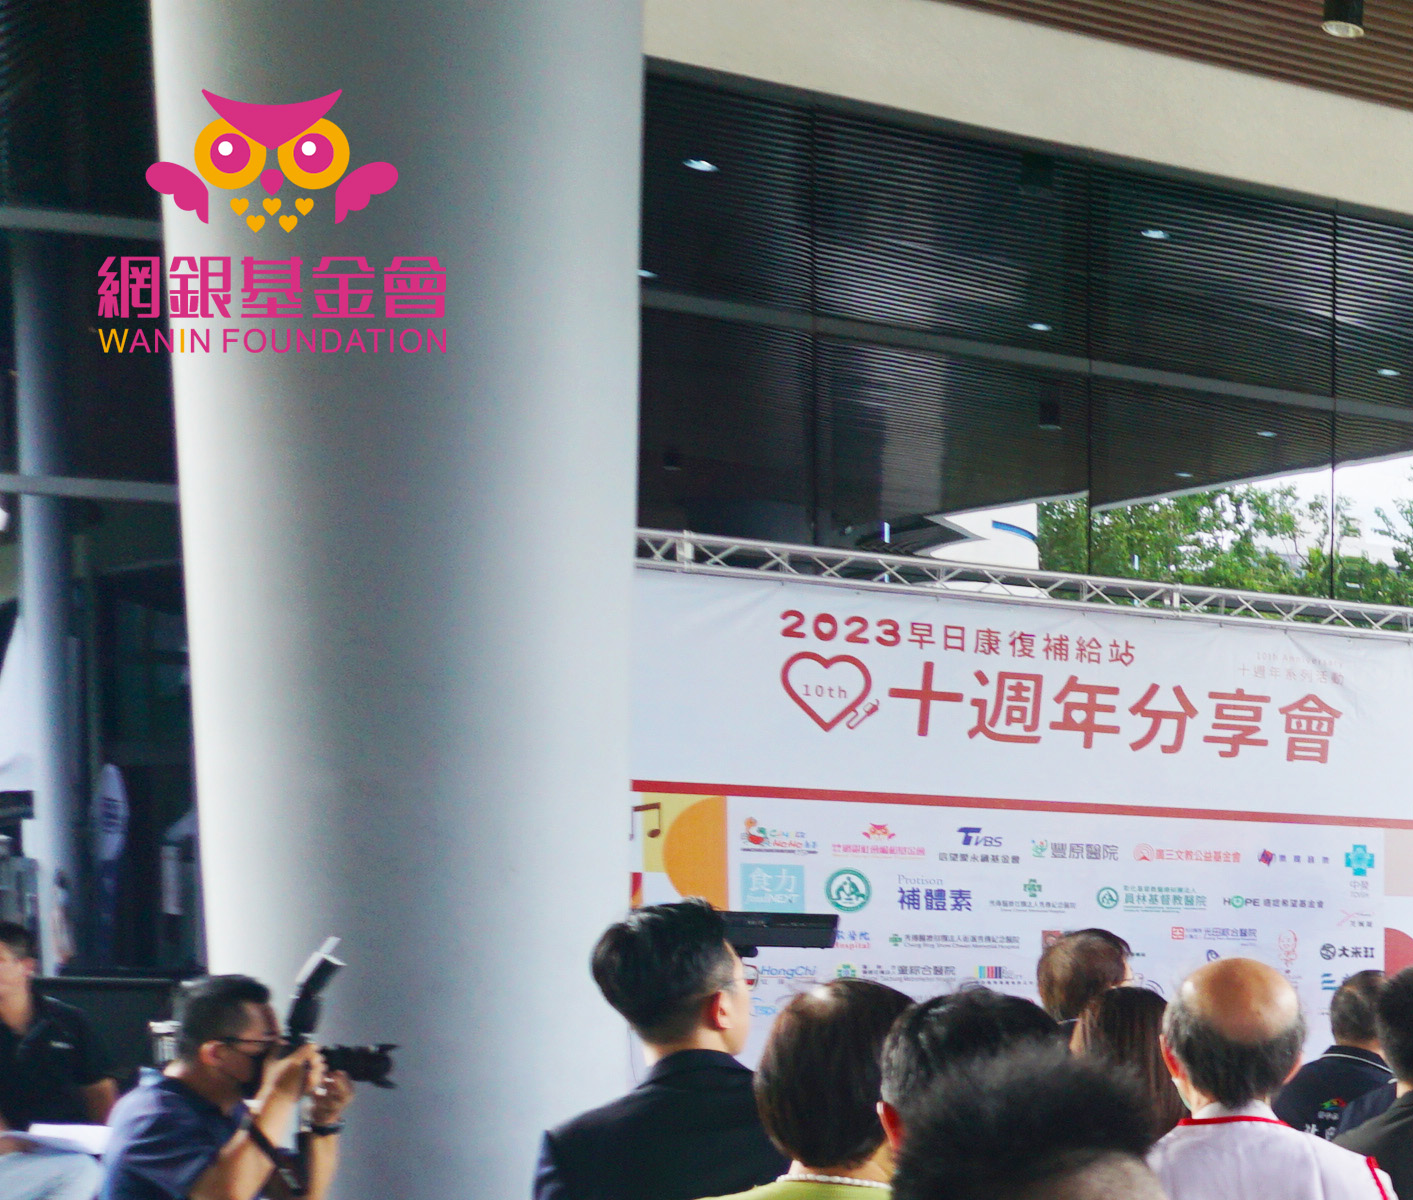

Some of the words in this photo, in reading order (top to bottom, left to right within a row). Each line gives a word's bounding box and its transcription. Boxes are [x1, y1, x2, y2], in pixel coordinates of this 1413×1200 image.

[801, 683, 849, 700] 10th
[888, 660, 1343, 764] 十週年分享會
[957, 826, 1003, 847] TVBS
[1050, 842, 1119, 861] 豐原醫院
[749, 867, 797, 893] 食力
[898, 887, 973, 911] 補體素
[1223, 895, 1260, 908] HOPE
